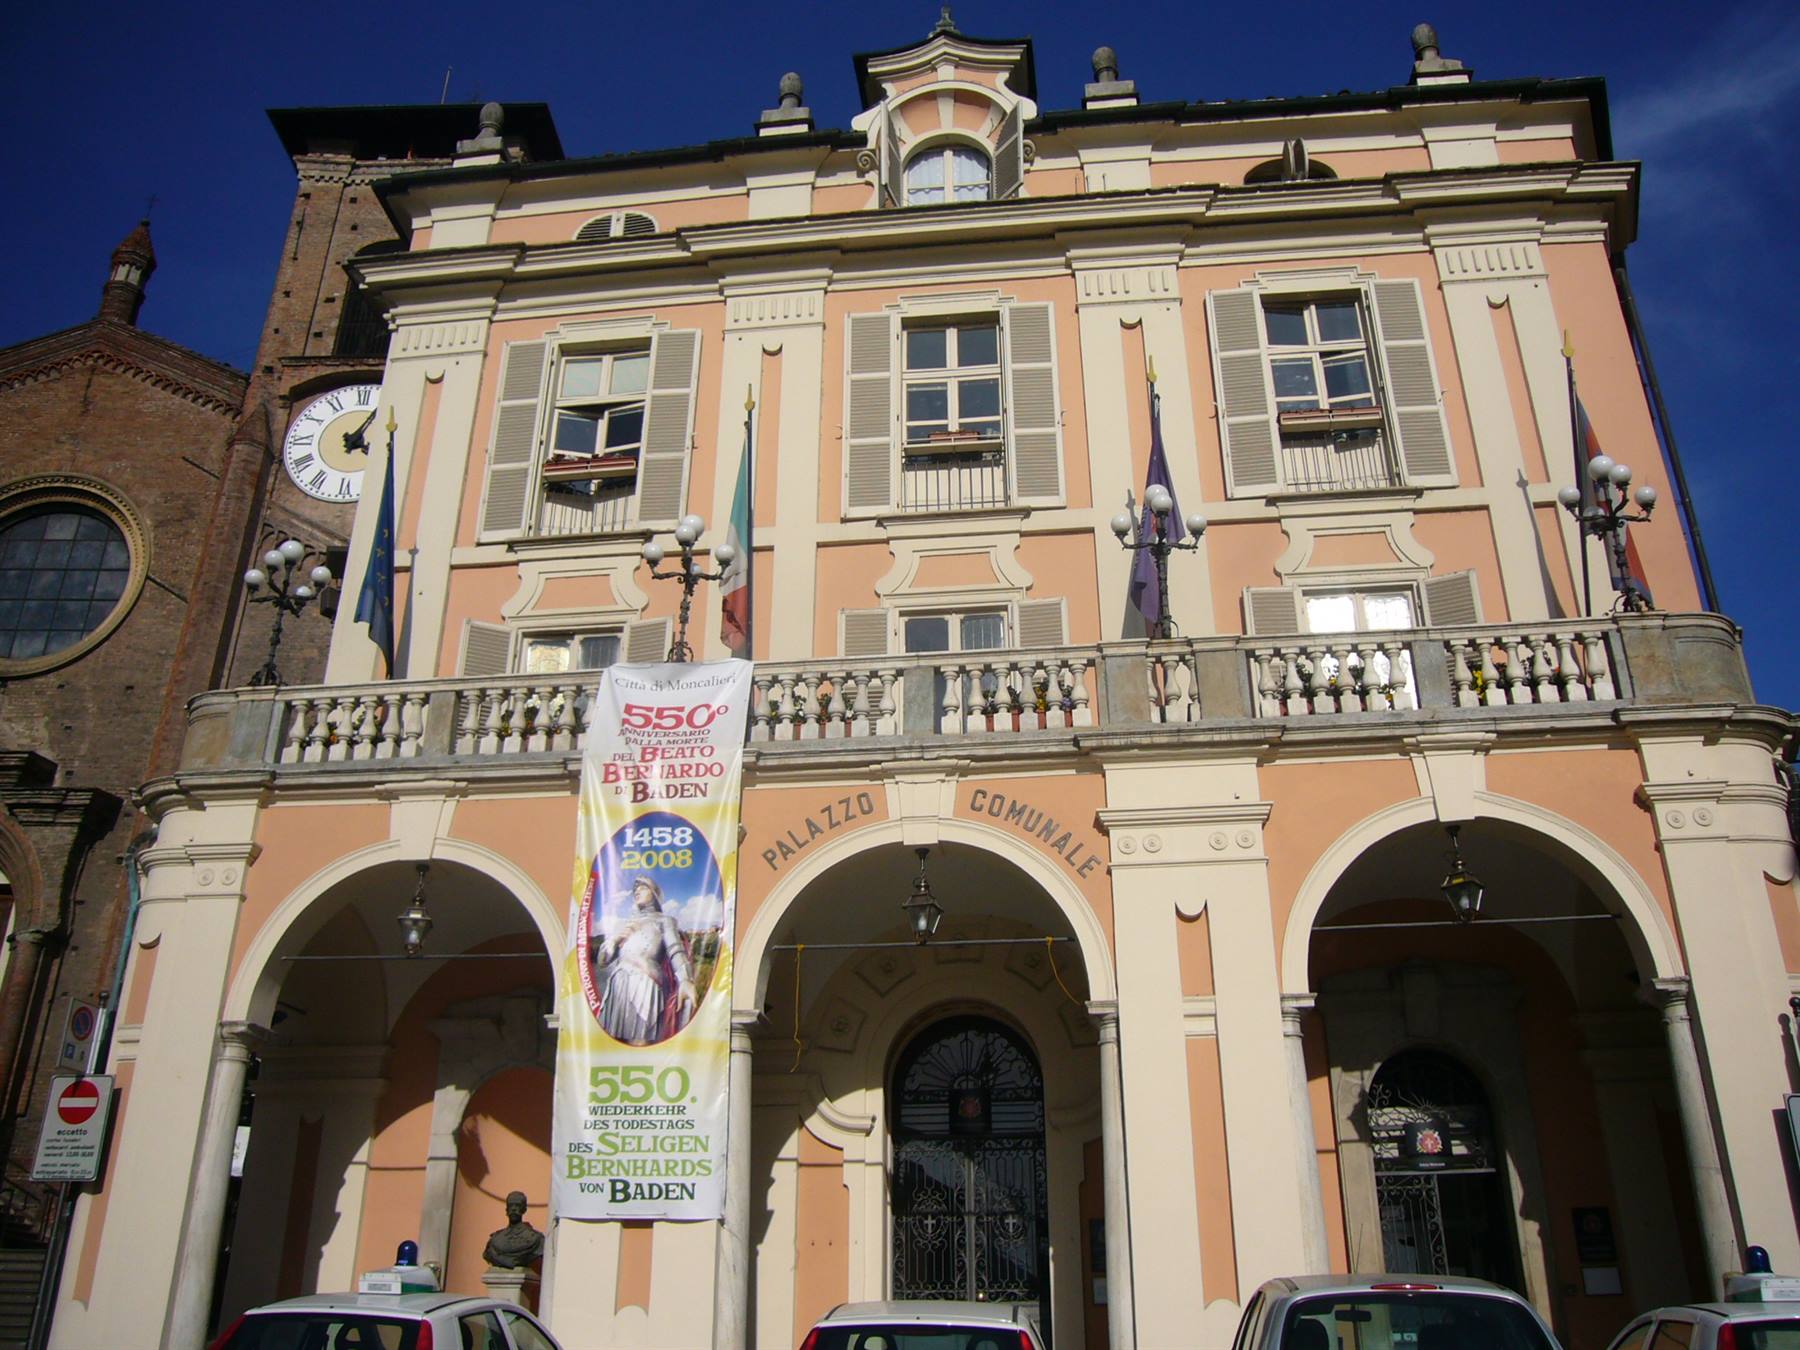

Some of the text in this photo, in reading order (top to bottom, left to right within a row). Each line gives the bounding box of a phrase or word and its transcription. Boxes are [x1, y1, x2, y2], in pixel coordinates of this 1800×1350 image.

[614, 672, 737, 692] Città di Moncalieri
[618, 727, 711, 738] ANNIVERSARIO
[625, 736, 710, 746] DALLA MORTE
[612, 745, 715, 763] DEL BEATO
[631, 781, 708, 803] BADEN
[623, 827, 694, 848] 1458
[761, 788, 1102, 880] PALAZZO COMUNALE
[620, 849, 694, 870] 2008
[588, 1065, 698, 1105] 550.
[588, 1105, 687, 1116] WIEDERKEHR
[584, 1119, 695, 1130] DES TODESTAGS
[568, 1132, 711, 1157] DES SELIGEN
[566, 1154, 713, 1179] BERNHARDS
[579, 1178, 697, 1203] VON BADEN
